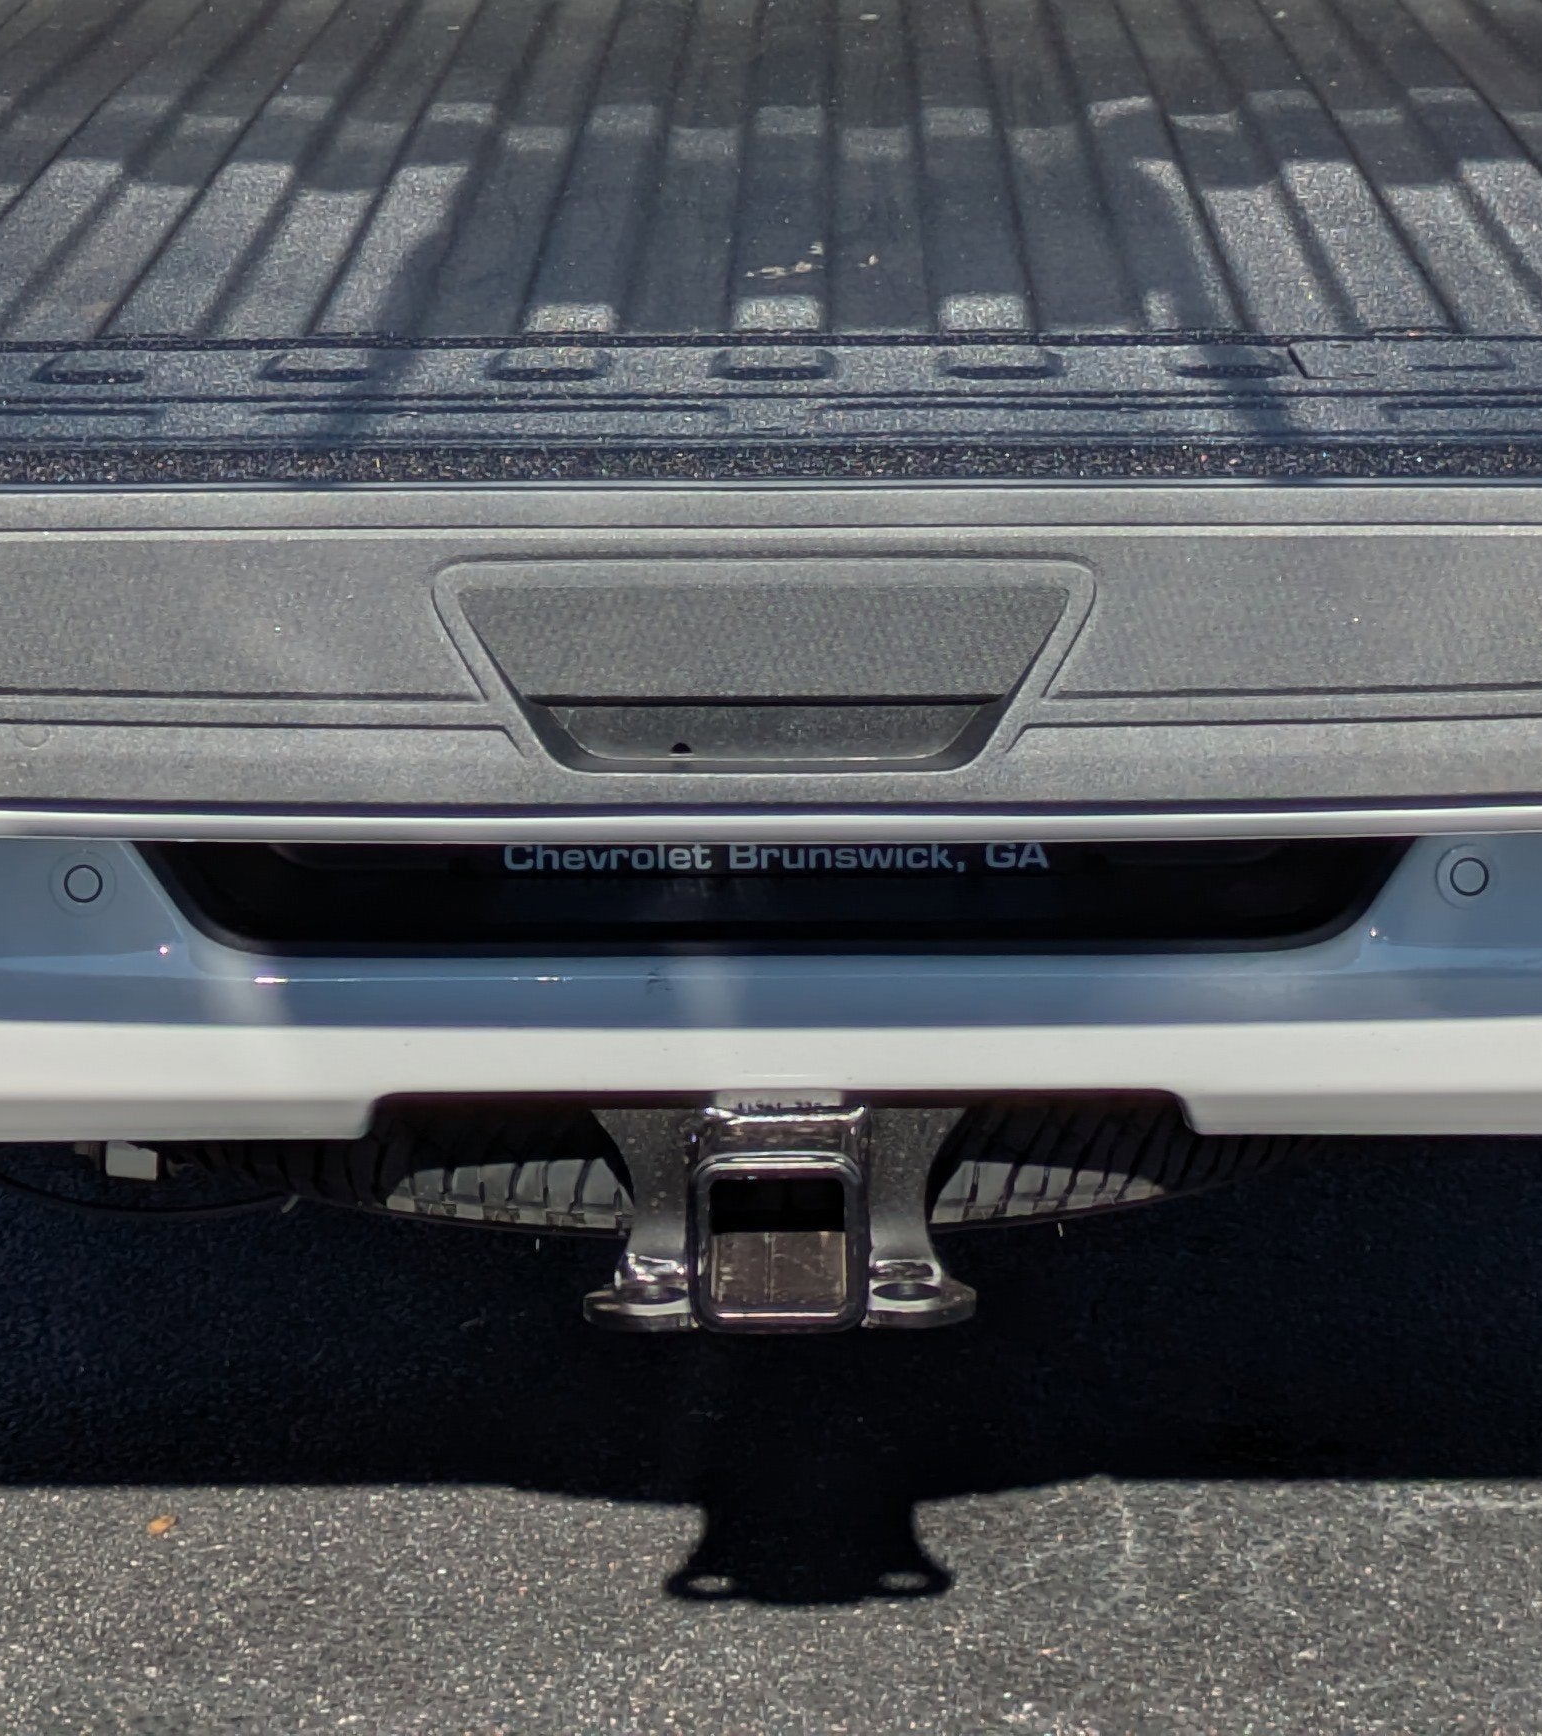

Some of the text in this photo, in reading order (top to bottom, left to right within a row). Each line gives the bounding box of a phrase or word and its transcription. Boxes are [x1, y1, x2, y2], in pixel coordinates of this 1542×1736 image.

[503, 842, 1051, 873] Chevrolet Brunswick, GA
